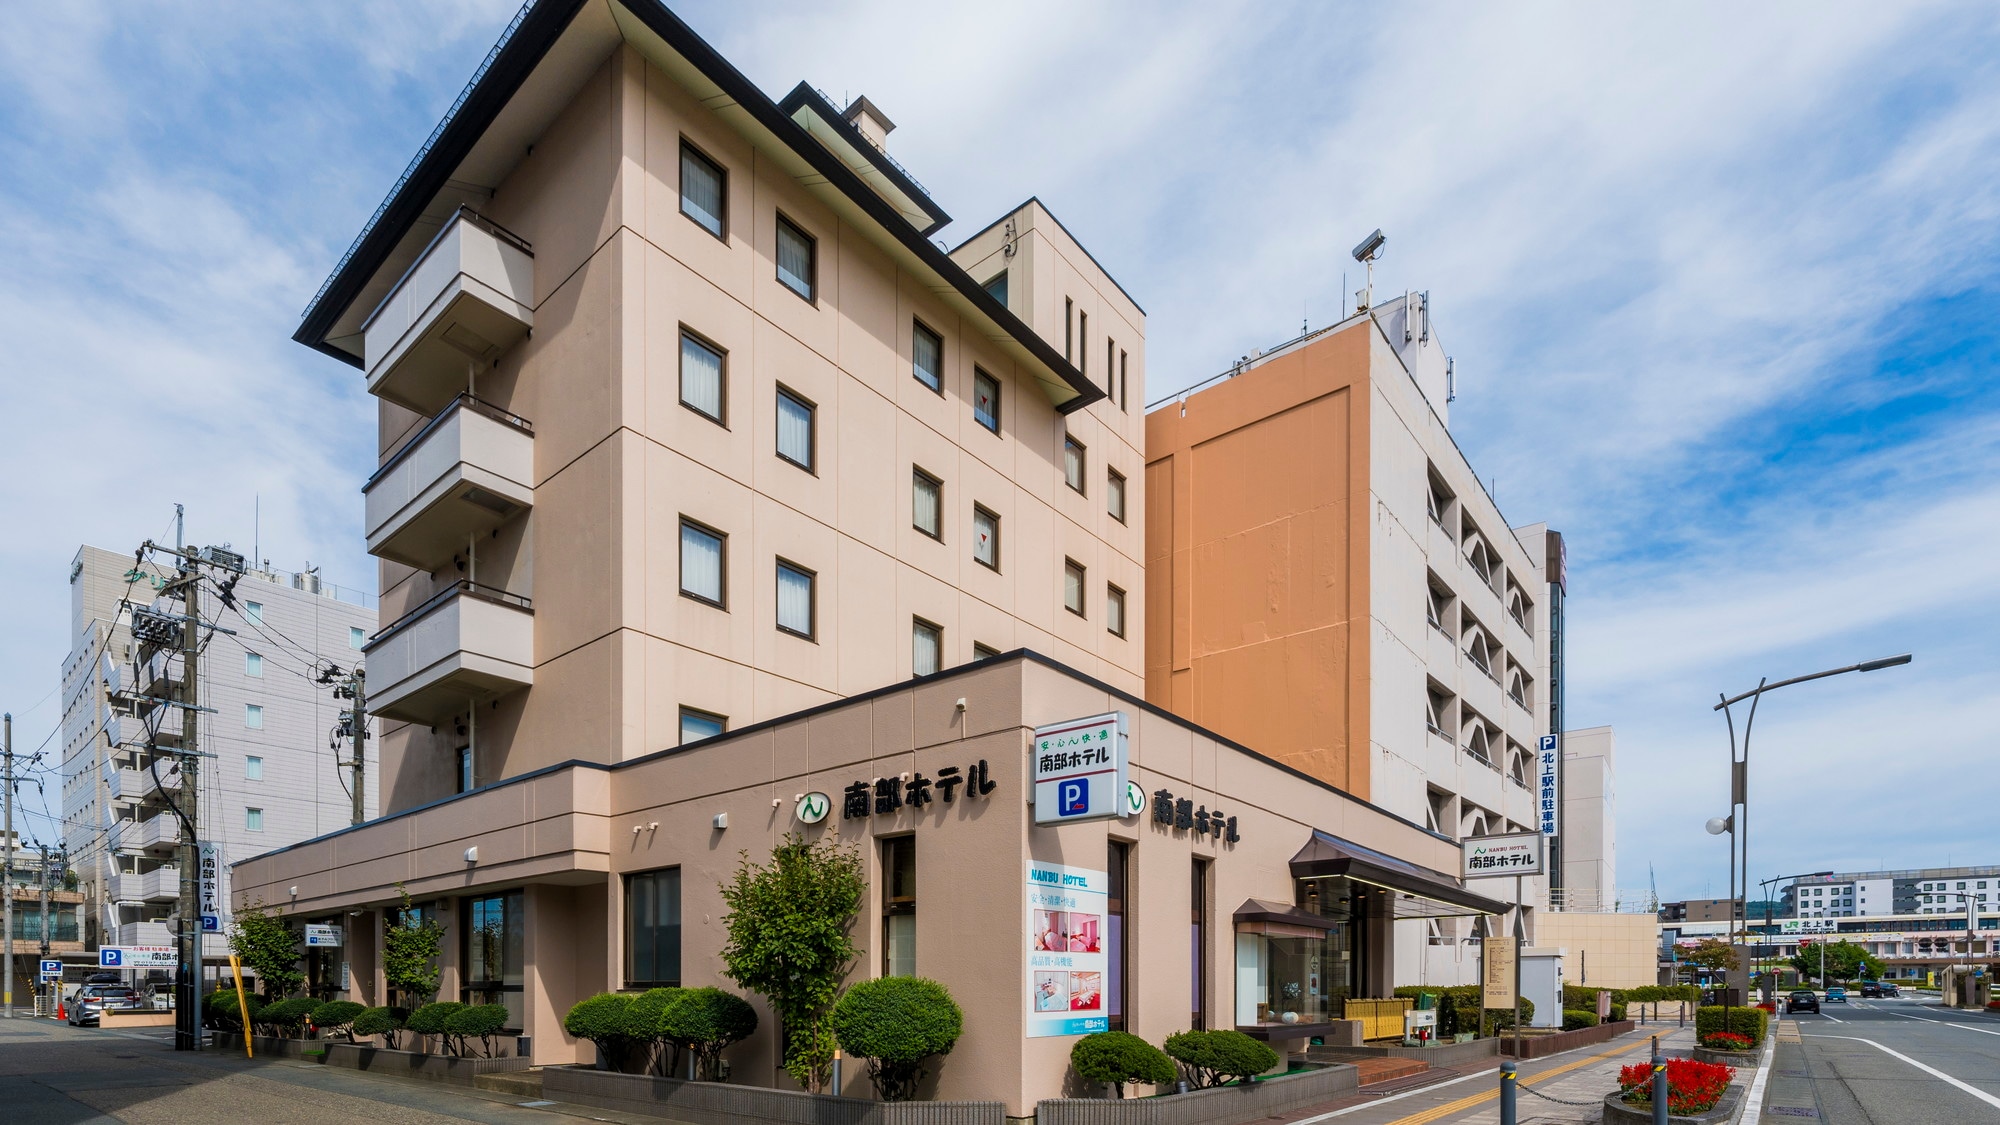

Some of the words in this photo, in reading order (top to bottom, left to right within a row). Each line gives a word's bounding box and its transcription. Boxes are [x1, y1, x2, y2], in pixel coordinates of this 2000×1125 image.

[1040, 747, 1109, 773] 南部ホテル
[844, 759, 997, 820] 南部ホテル
[1065, 785, 1081, 811] P
[1541, 753, 1555, 834] 北上駅前駐車場
[1154, 789, 1240, 843] 南部ホテル
[1469, 854, 1535, 869] 南部ホテル
[202, 858, 215, 912] 南部ホテル
[1031, 869, 1059, 884] NANBU
[1062, 874, 1088, 887] HOTEL
[1801, 920, 1834, 928] 北上駅
[106, 952, 117, 964] P
